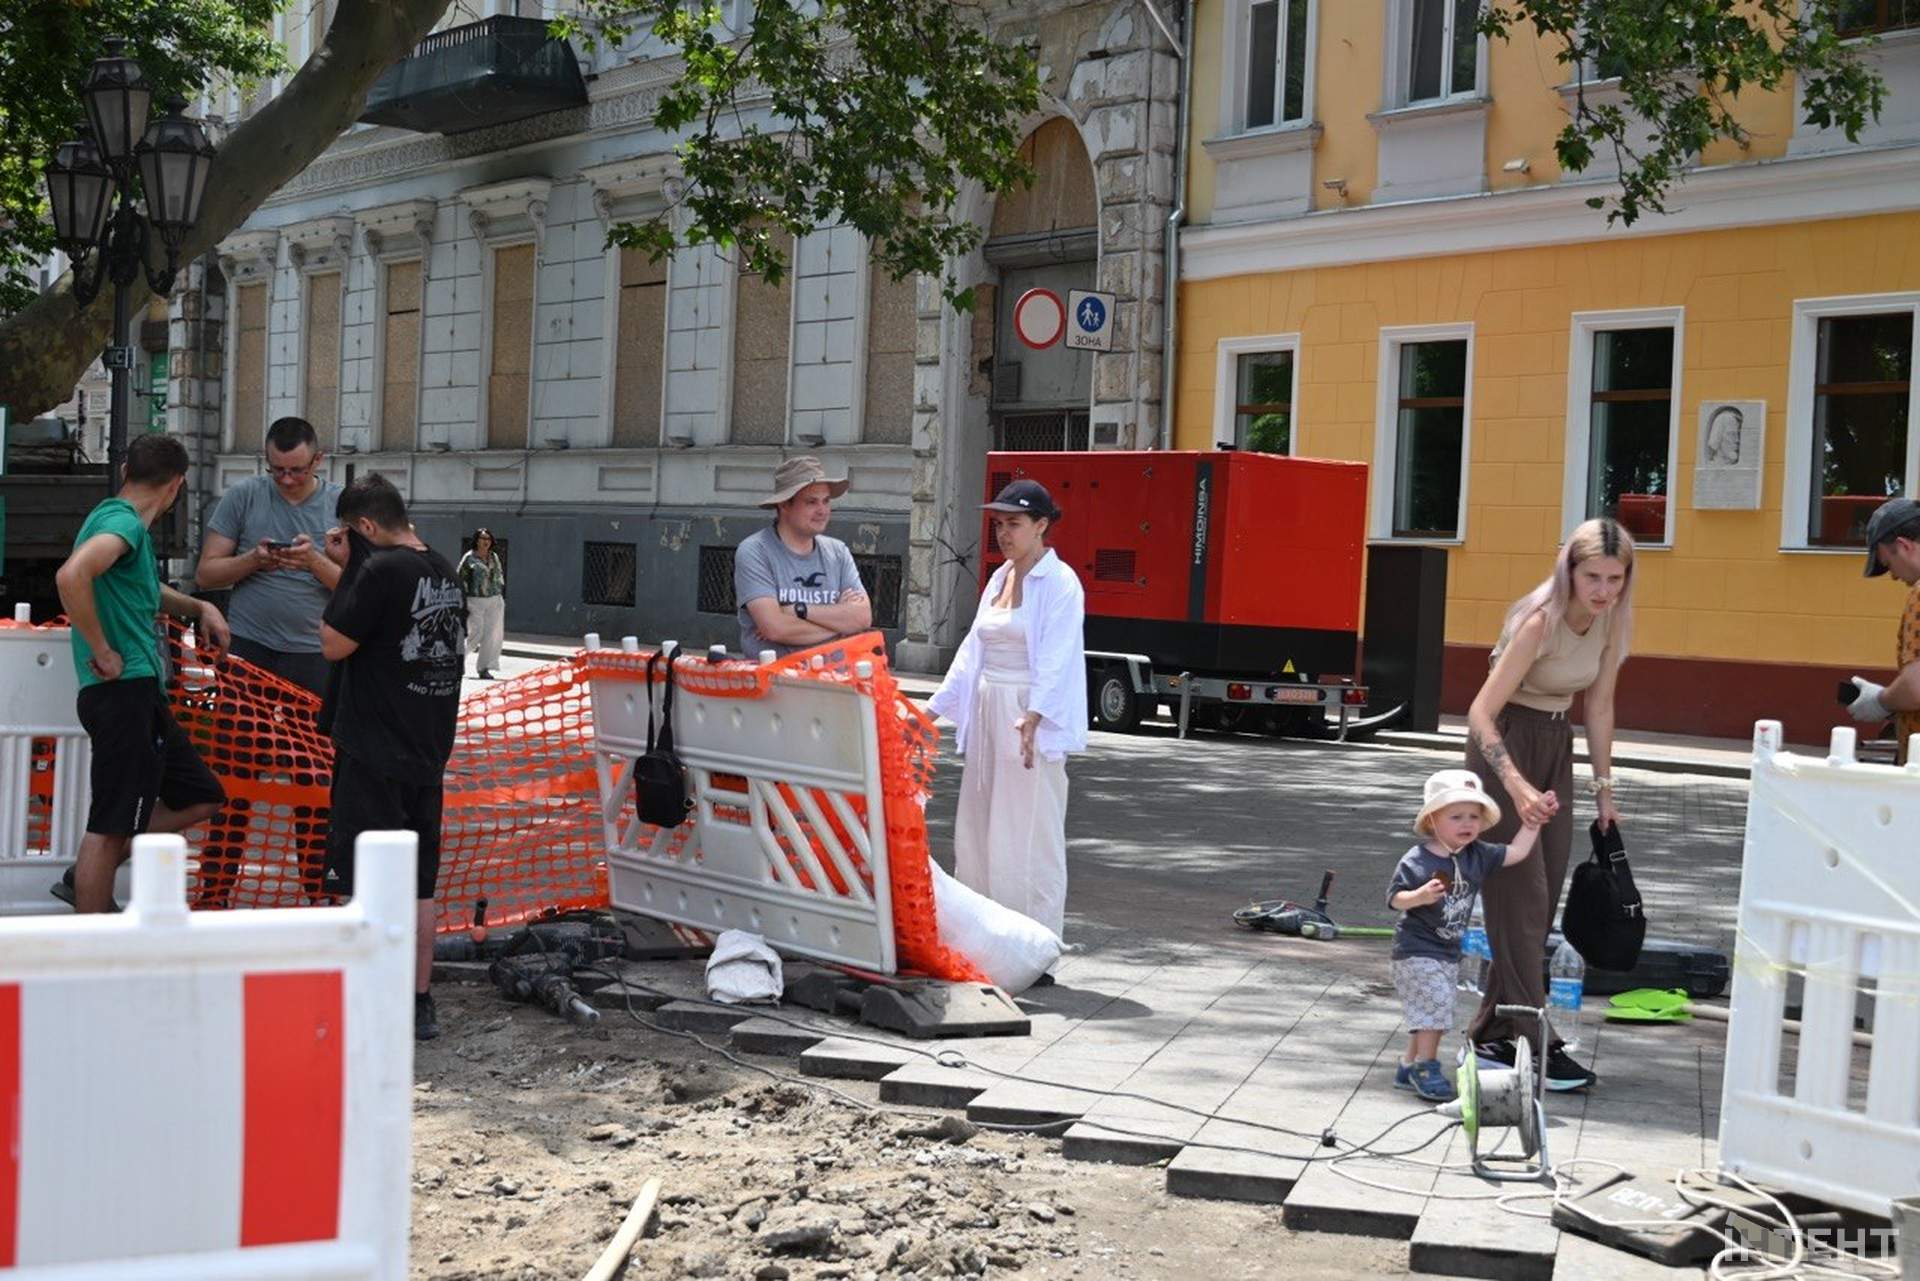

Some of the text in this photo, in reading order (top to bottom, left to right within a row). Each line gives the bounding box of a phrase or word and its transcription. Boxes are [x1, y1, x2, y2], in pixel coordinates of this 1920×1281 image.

[1074, 335, 1102, 347] ЗОНА
[1194, 478, 1208, 564] HIMOINSA
[406, 682, 428, 695] AND
